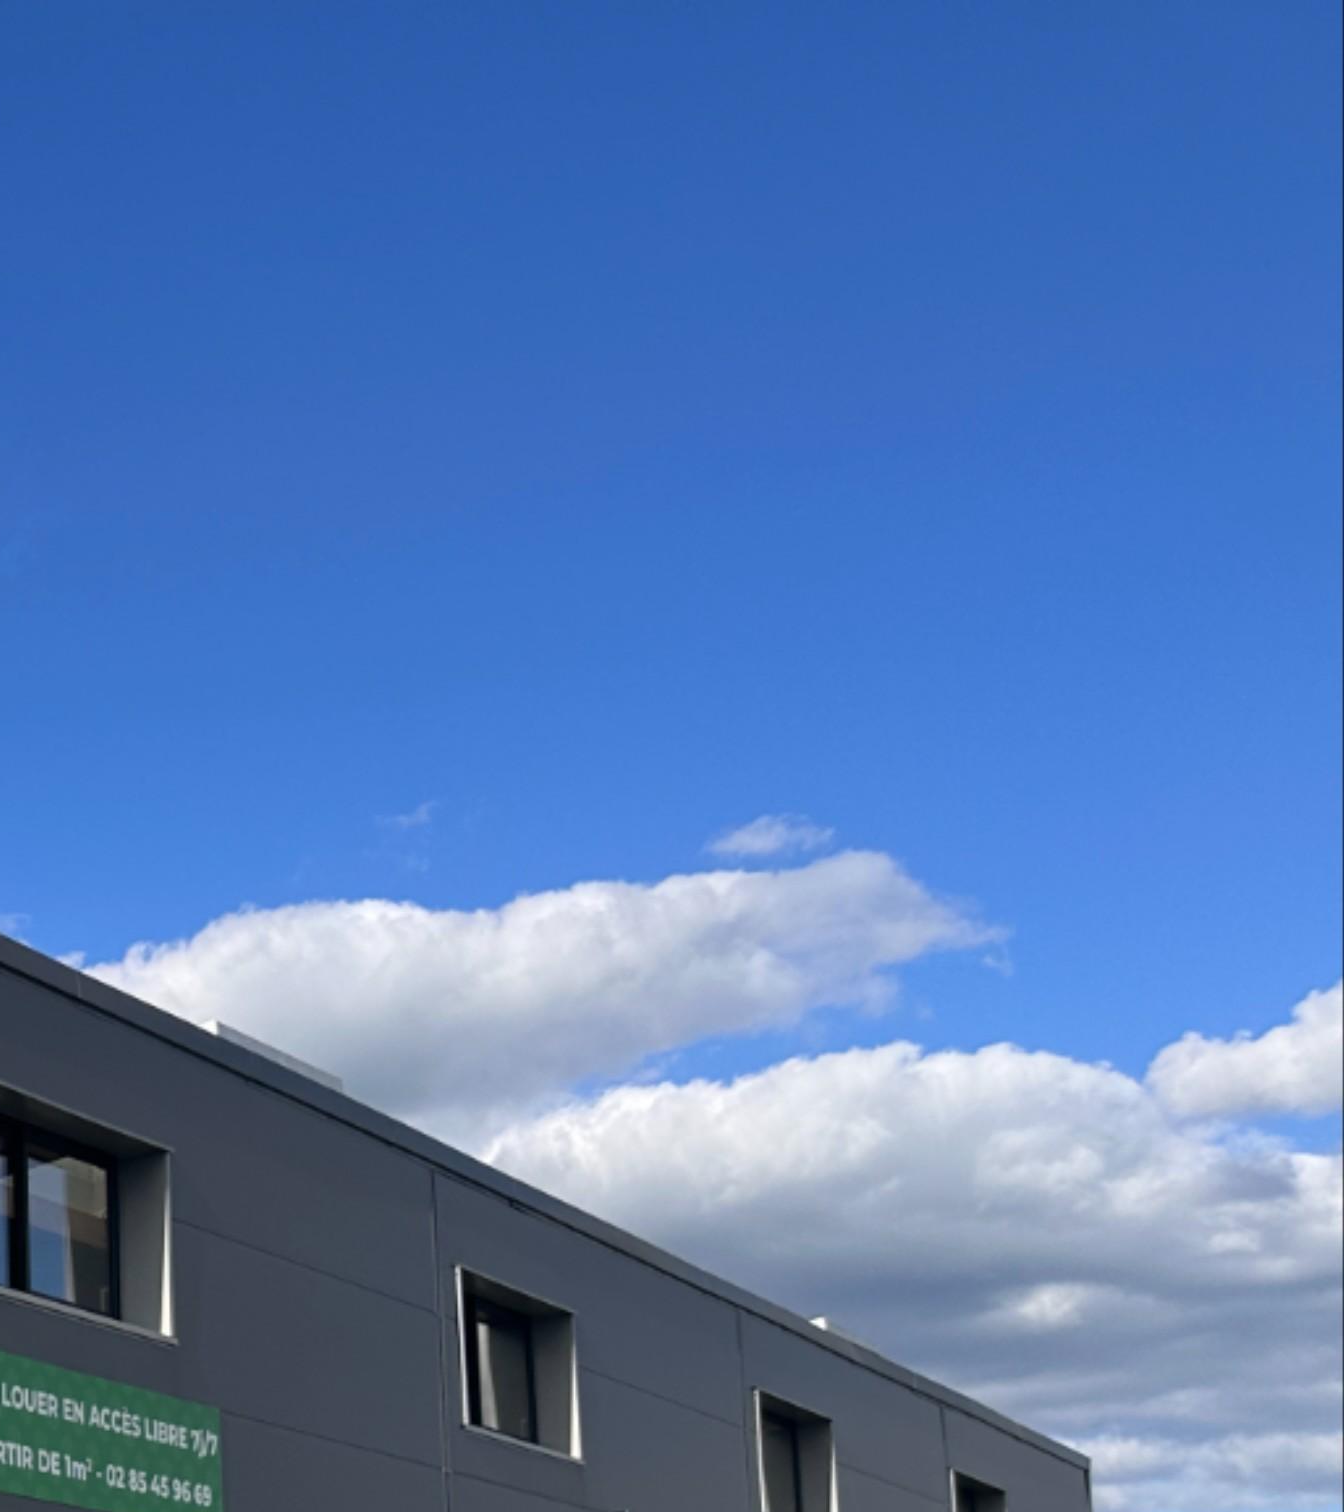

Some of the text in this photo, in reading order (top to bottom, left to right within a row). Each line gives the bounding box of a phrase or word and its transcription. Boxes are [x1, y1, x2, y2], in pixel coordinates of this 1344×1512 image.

[1, 1382, 58, 1418] LOUER
[63, 1398, 84, 1425] EN
[88, 1404, 141, 1438] ACCÈS
[144, 1419, 188, 1449] LIBRE
[38, 1449, 61, 1476] DE
[105, 1463, 126, 1488] 02
[129, 1469, 147, 1493] 85
[150, 1474, 170, 1498] 45
[173, 1479, 192, 1502] 96
[194, 1483, 212, 1507] 69
